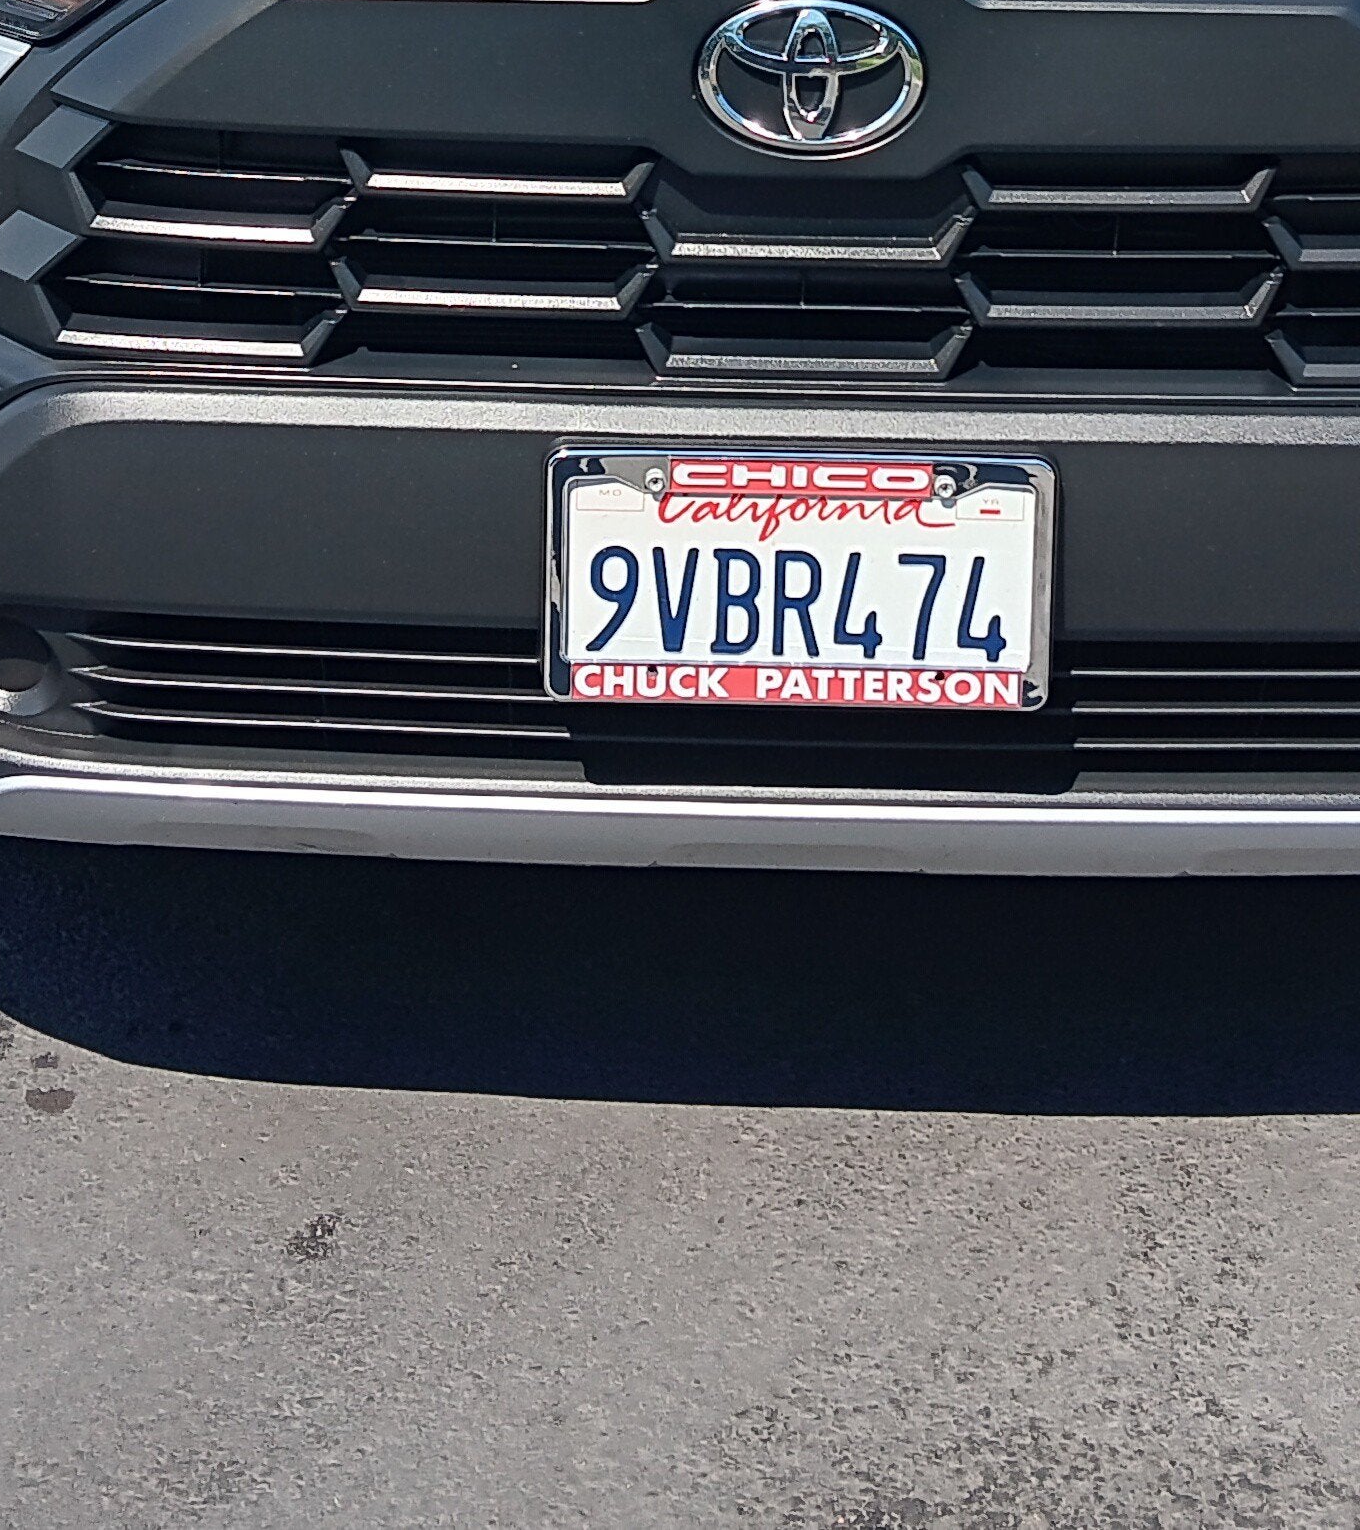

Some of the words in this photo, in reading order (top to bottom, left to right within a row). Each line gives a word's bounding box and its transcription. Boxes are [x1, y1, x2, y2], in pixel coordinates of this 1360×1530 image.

[671, 461, 931, 491] CHICO
[658, 491, 956, 542] California
[585, 545, 1008, 663] 9VBR474
[573, 664, 730, 699] CHUCK
[755, 667, 1021, 706] PATTERSON
